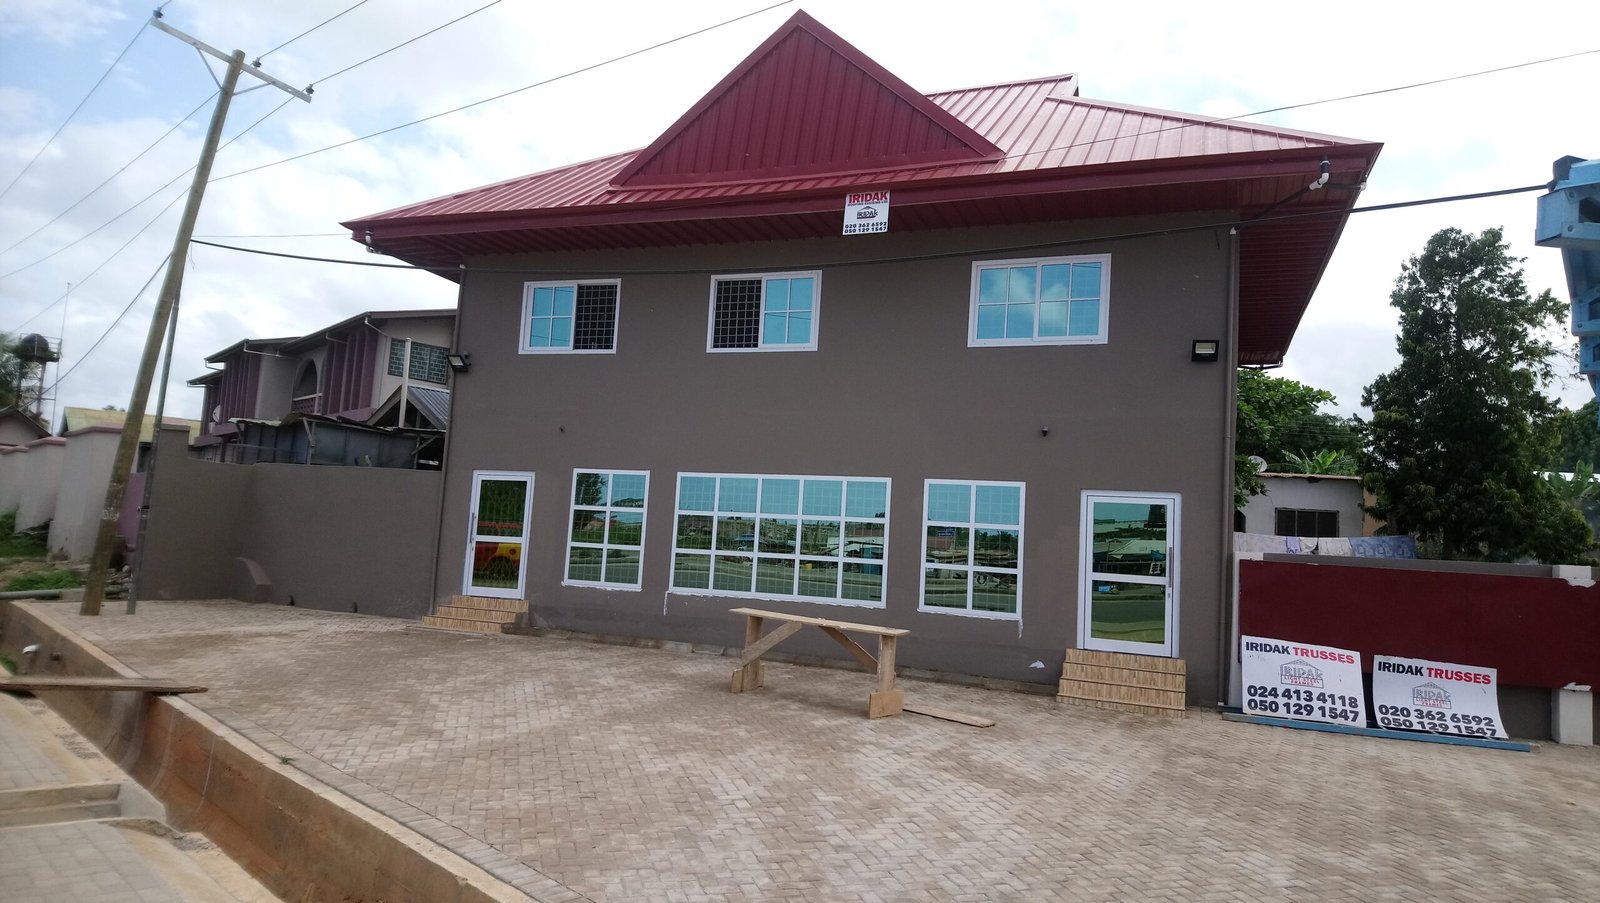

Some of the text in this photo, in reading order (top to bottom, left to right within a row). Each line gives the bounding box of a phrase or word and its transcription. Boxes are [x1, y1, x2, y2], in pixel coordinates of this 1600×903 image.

[848, 192, 888, 203] IRIDAK
[1246, 642, 1355, 664] IRIDAK TRUSSES
[1378, 661, 1491, 685] IRIDAK TRUSSES
[1248, 685, 1358, 708] 024 413 4118
[1248, 698, 1359, 722] 050 129 1547
[1378, 704, 1495, 727] 020 362 6592
[1380, 716, 1496, 737] 050 129 1547
